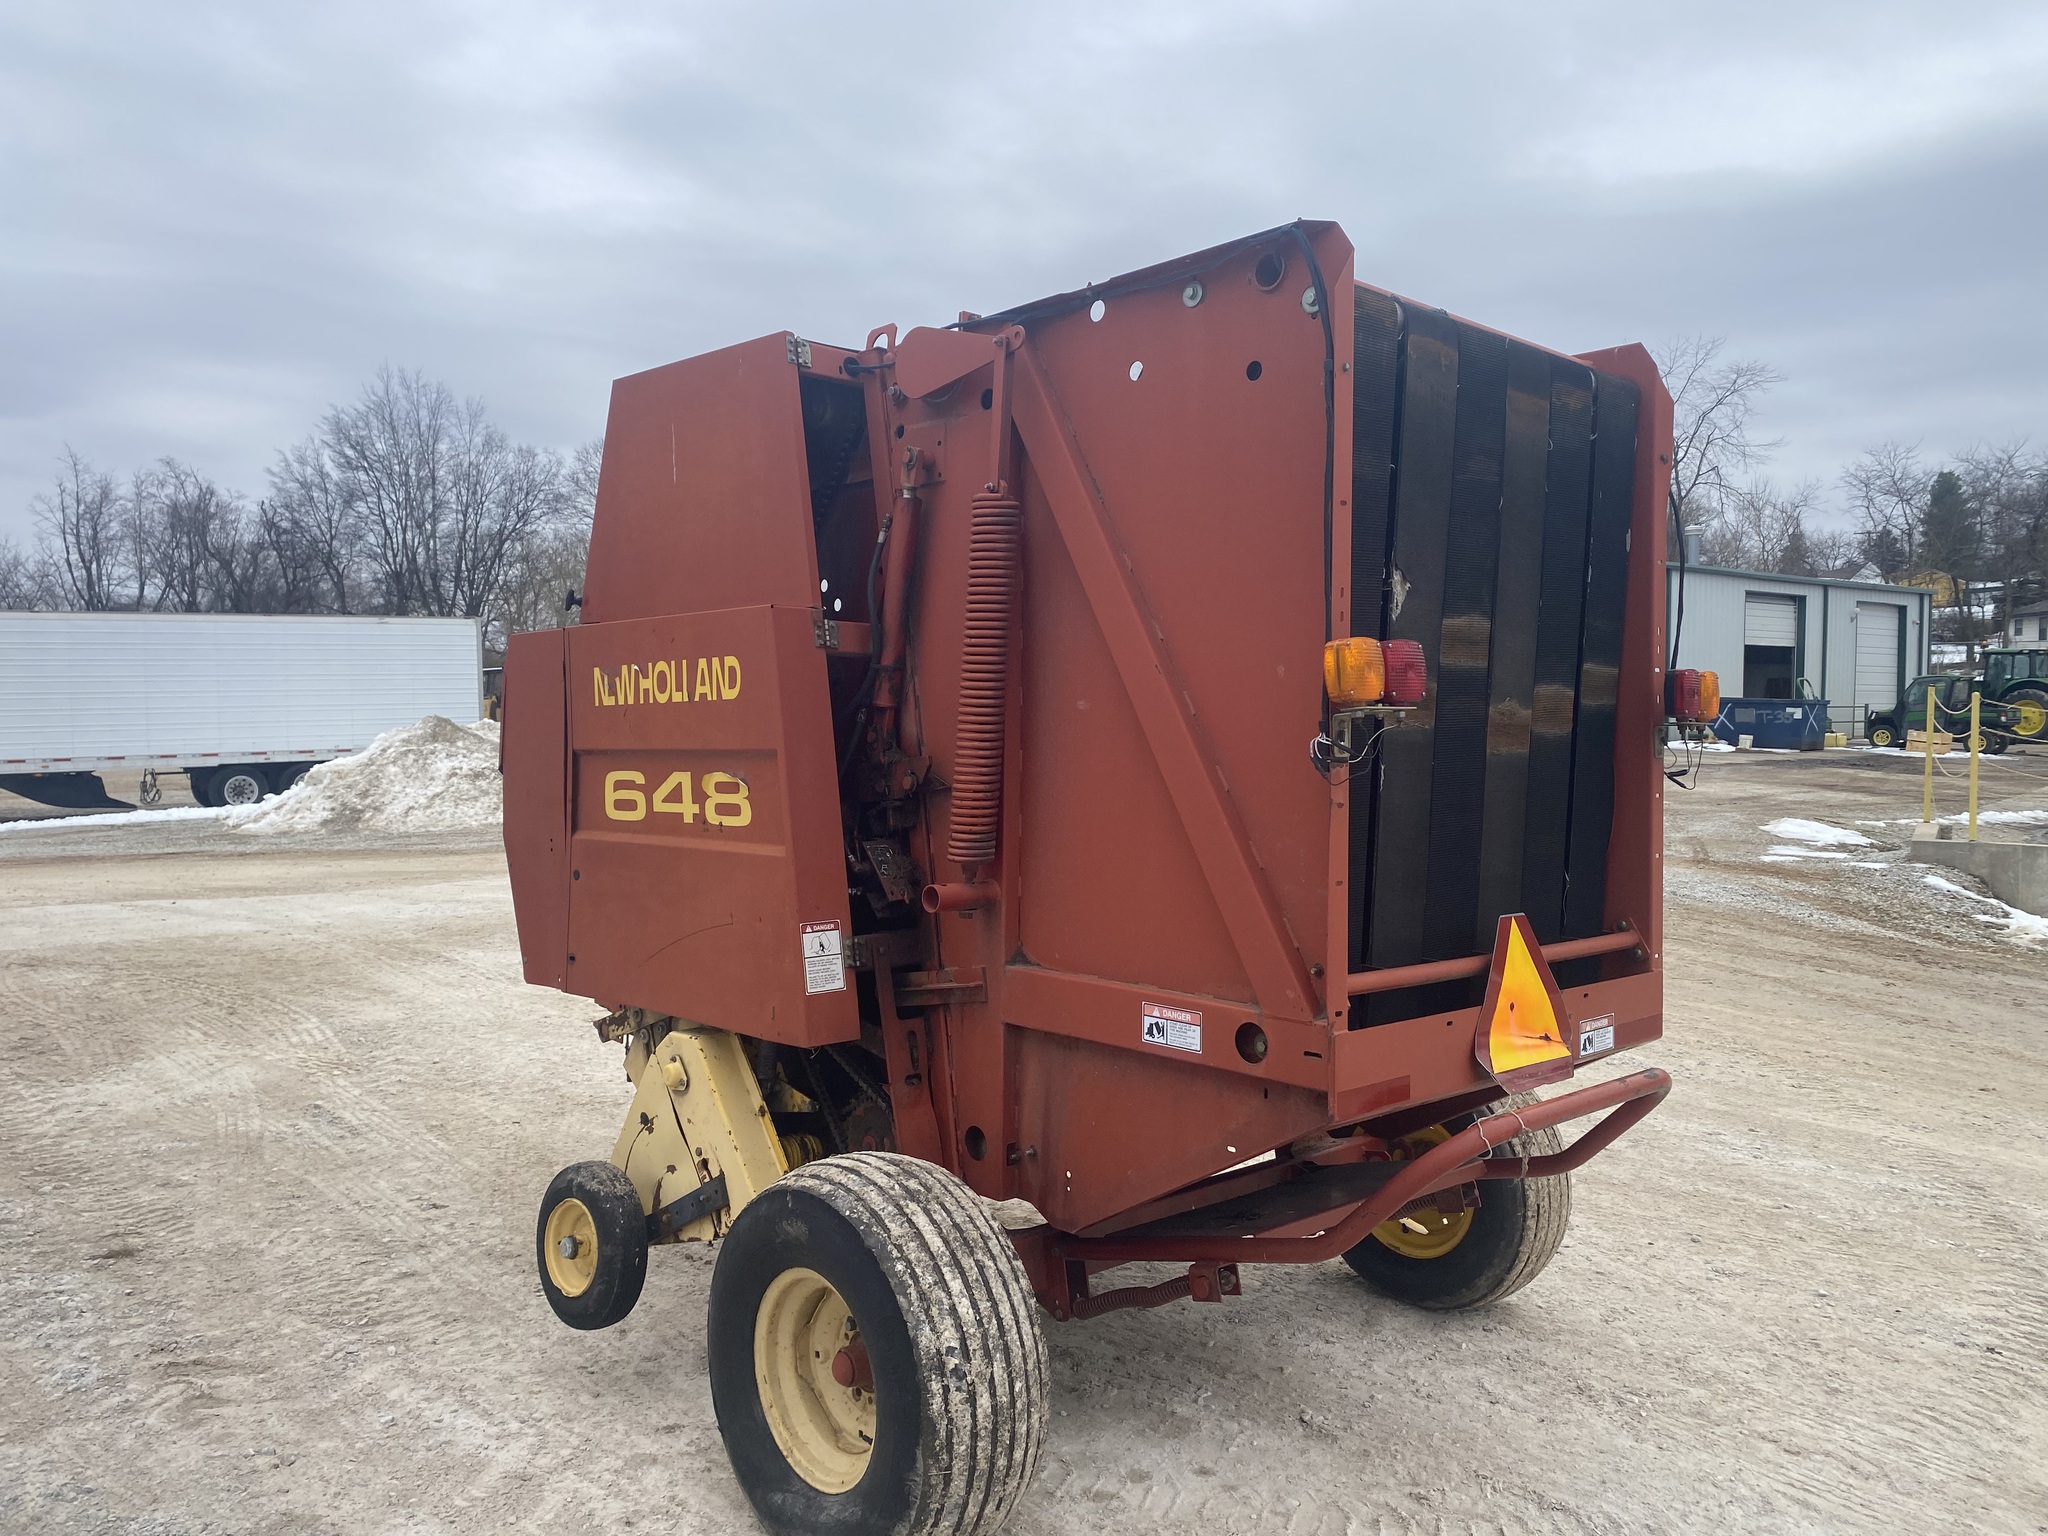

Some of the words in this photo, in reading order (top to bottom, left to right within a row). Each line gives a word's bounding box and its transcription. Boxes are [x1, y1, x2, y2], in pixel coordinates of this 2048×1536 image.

[604, 770, 752, 827] 648
[813, 923, 835, 931] DANGER
[1162, 1009, 1191, 1022] DANGER
